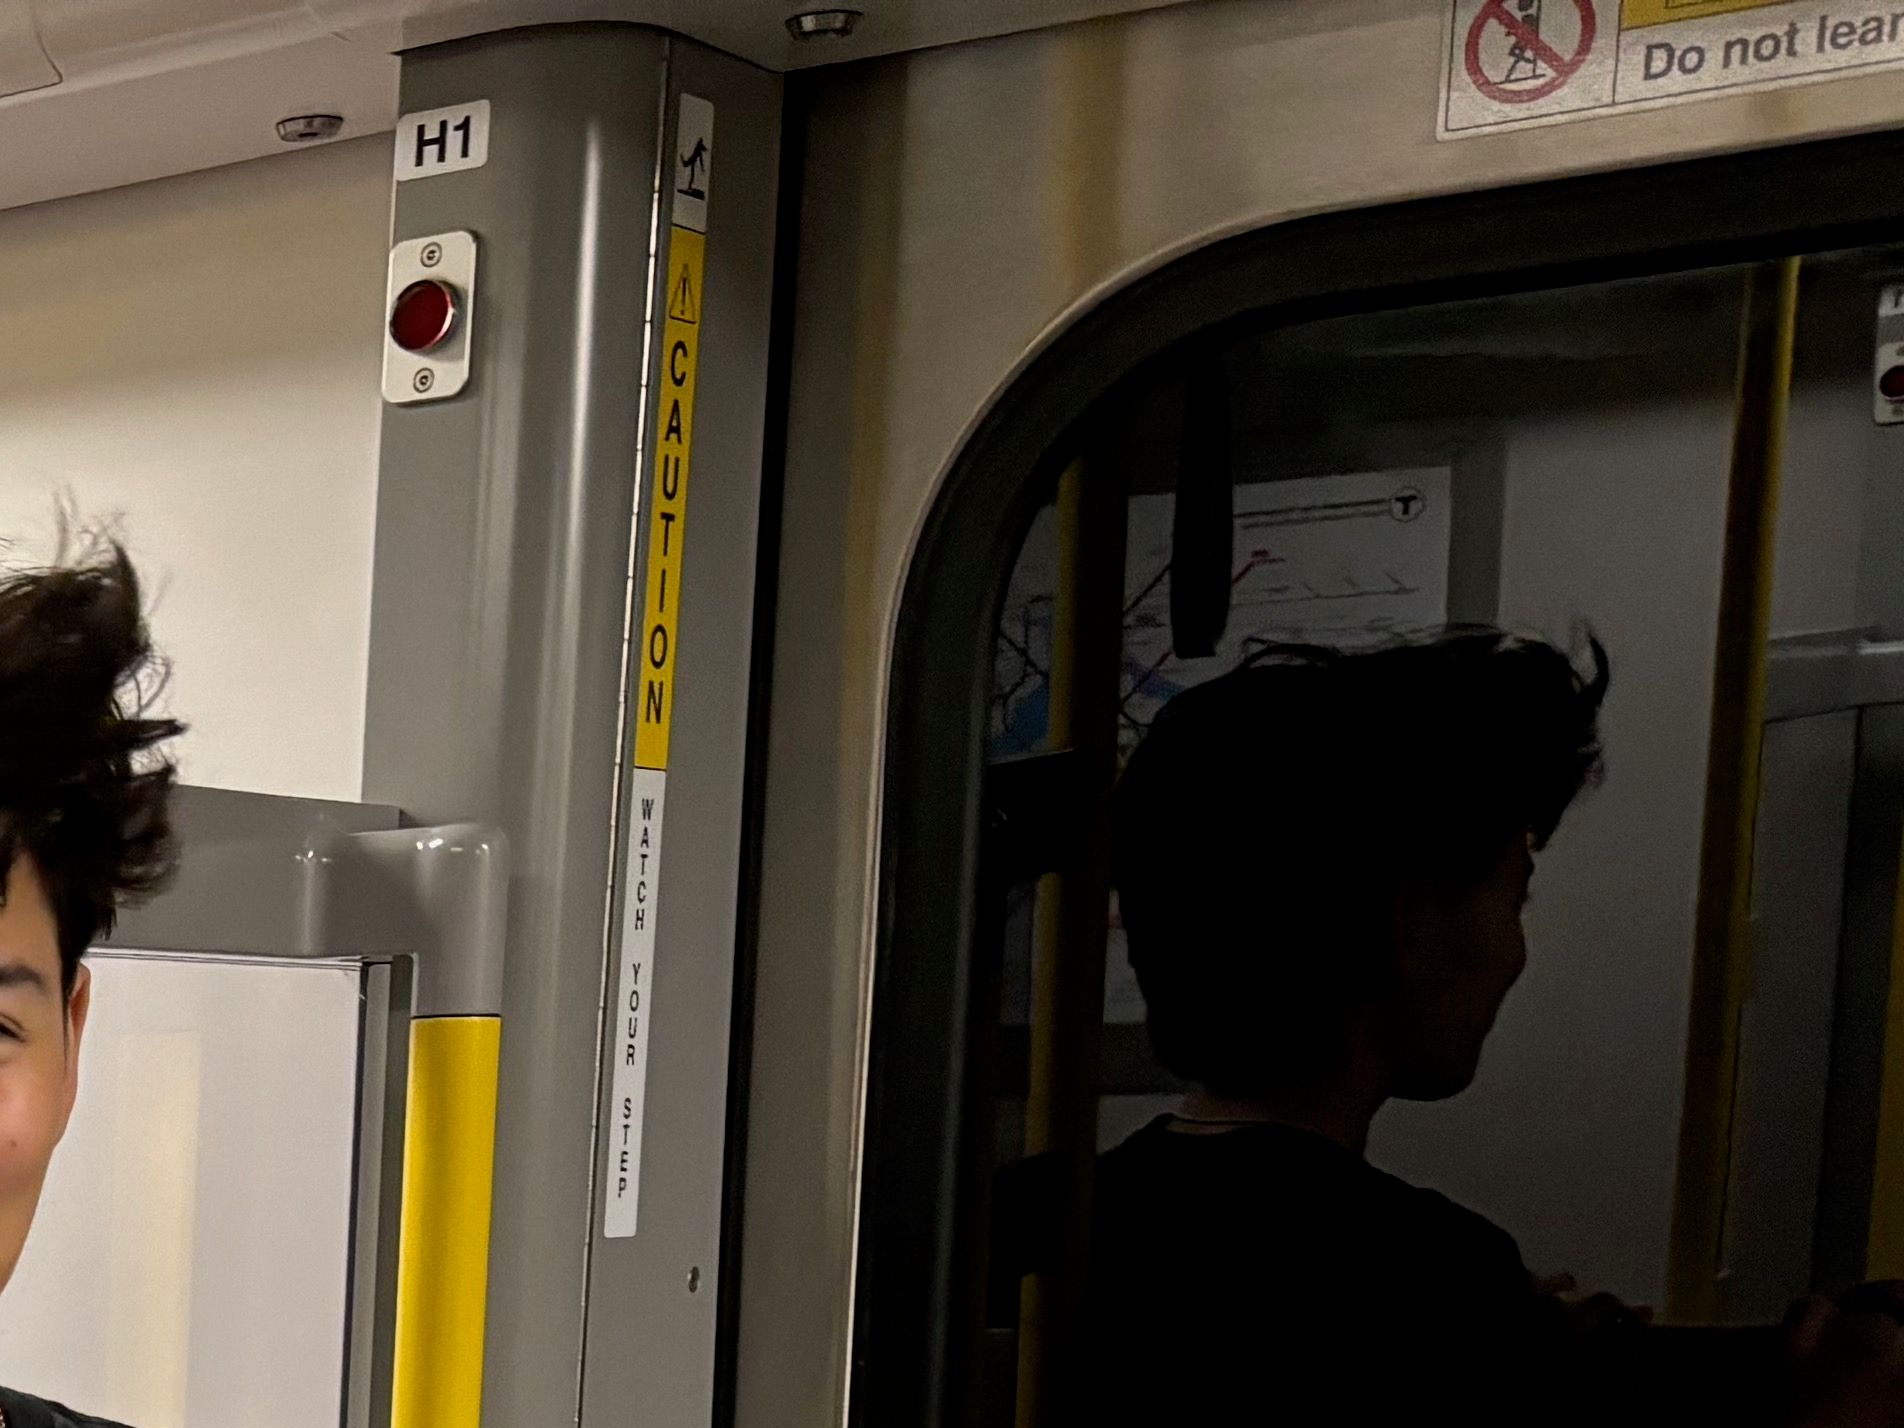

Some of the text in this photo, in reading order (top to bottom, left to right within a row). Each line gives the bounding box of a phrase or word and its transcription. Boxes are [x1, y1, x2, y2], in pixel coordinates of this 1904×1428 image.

[1643, 42, 1705, 81] Do
[1722, 20, 1800, 69] not
[415, 115, 470, 167] H1
[643, 339, 688, 726] CAUTION
[634, 798, 655, 931] WATCH
[626, 963, 642, 1067] YOUR
[617, 1098, 632, 1199] STEP
